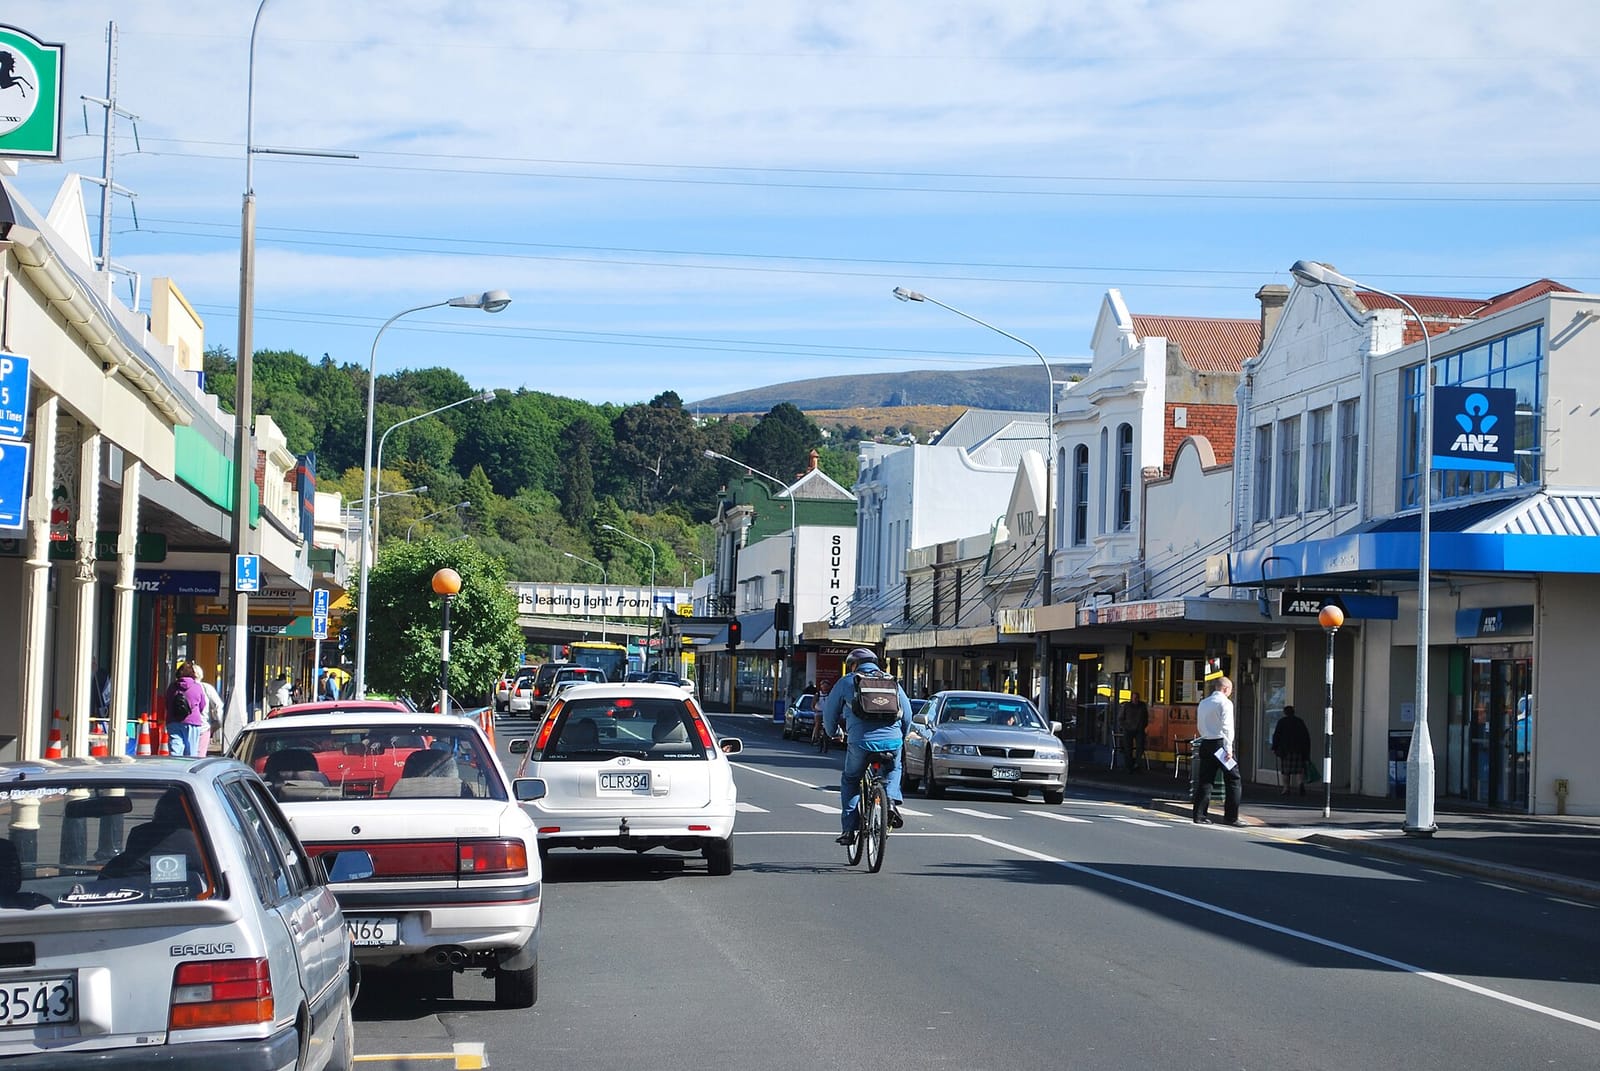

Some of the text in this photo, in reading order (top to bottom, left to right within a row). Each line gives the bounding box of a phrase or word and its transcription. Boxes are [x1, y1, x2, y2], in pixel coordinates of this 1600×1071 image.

[2, 387, 9, 405] 5
[6, 410, 22, 422] Times
[1450, 434, 1499, 452] ANZ
[244, 558, 251, 568] P
[831, 535, 841, 589] SOUTH
[134, 577, 160, 591] bnz
[535, 595, 579, 608] leading
[583, 595, 612, 609] light!
[616, 596, 649, 608] From
[1288, 600, 1320, 612] ANZ
[601, 775, 647, 789] CLR384
[170, 942, 235, 957] BARINA
